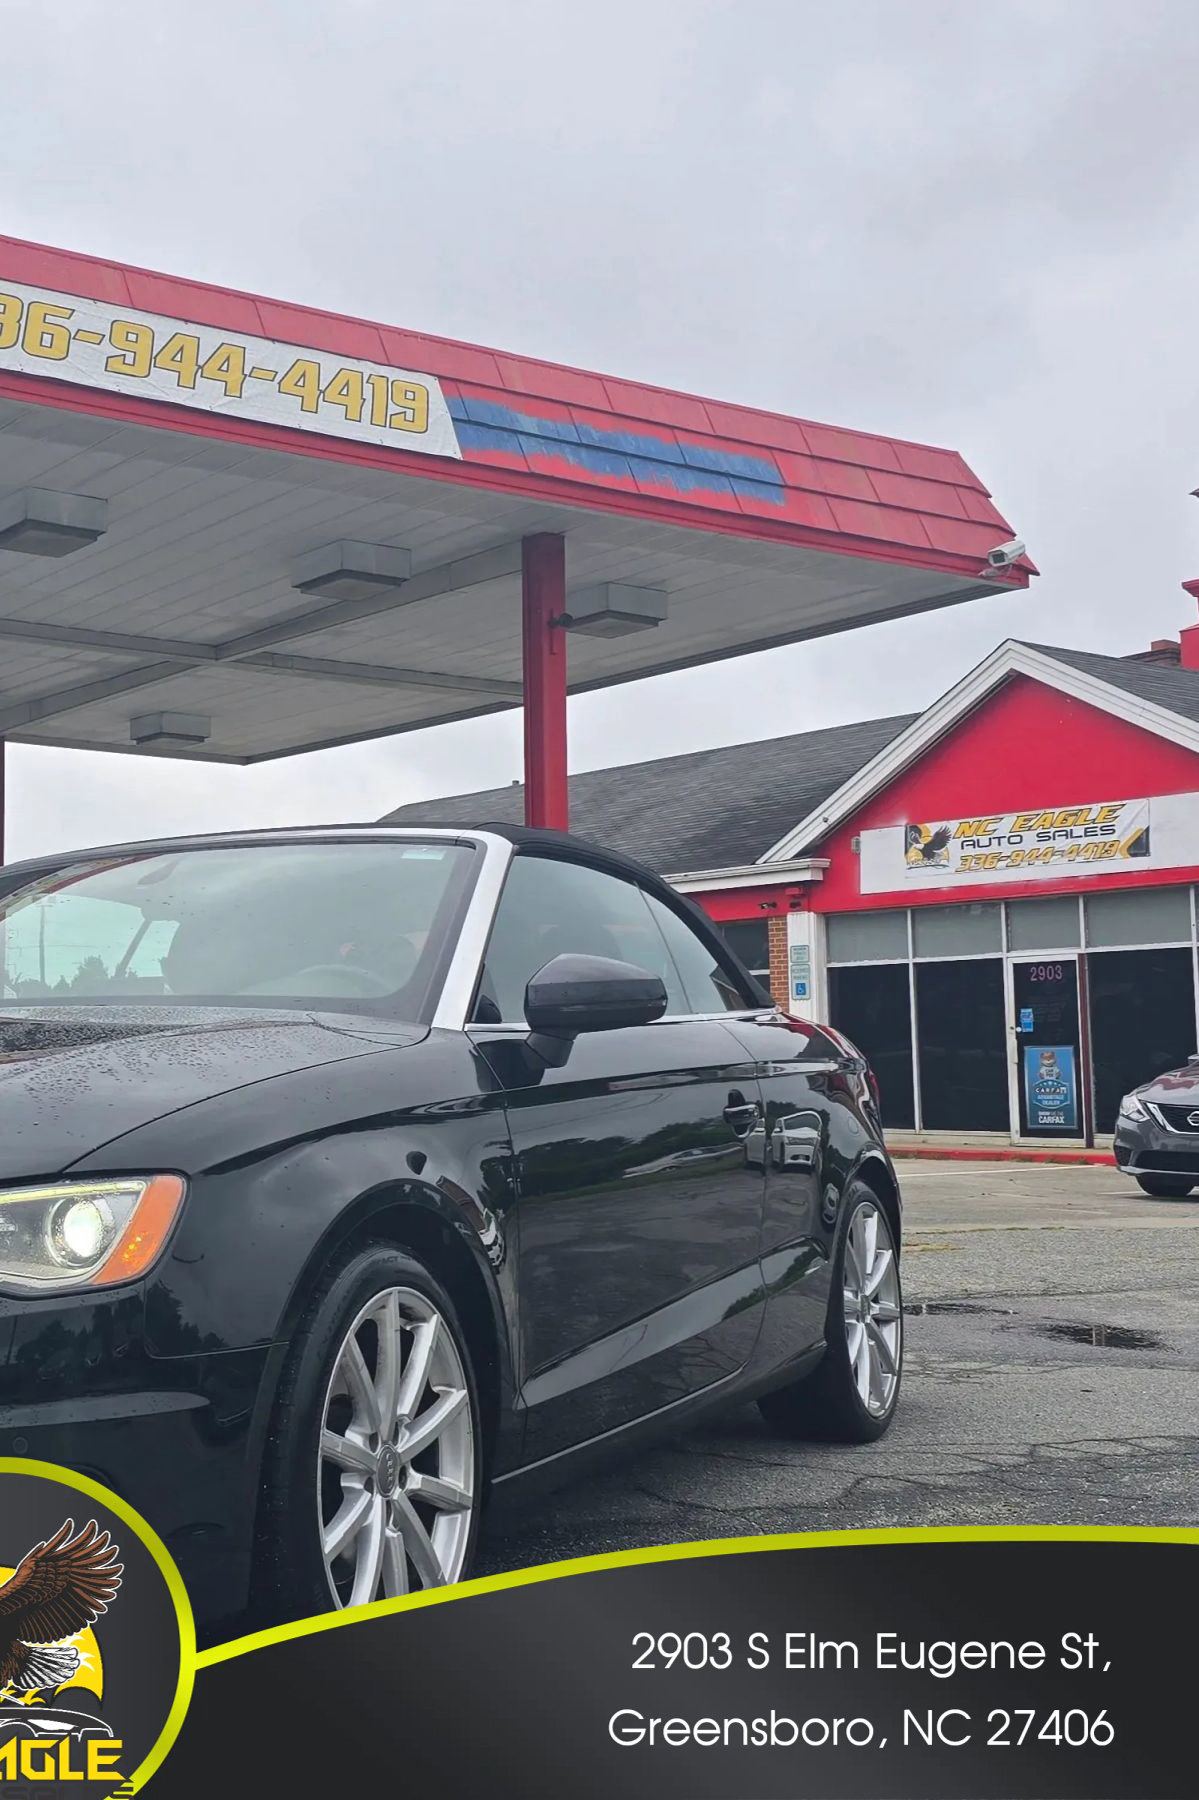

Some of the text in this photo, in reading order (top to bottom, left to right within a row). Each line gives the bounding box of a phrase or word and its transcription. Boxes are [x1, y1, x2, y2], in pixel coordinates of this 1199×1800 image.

[953, 804, 1127, 840] NC EAGLE
[961, 824, 1116, 850] AUTO SALES
[955, 840, 1120, 873] 336-944-4419
[1030, 965, 1063, 981] 2903
[1038, 1116, 1064, 1124] CARFAX
